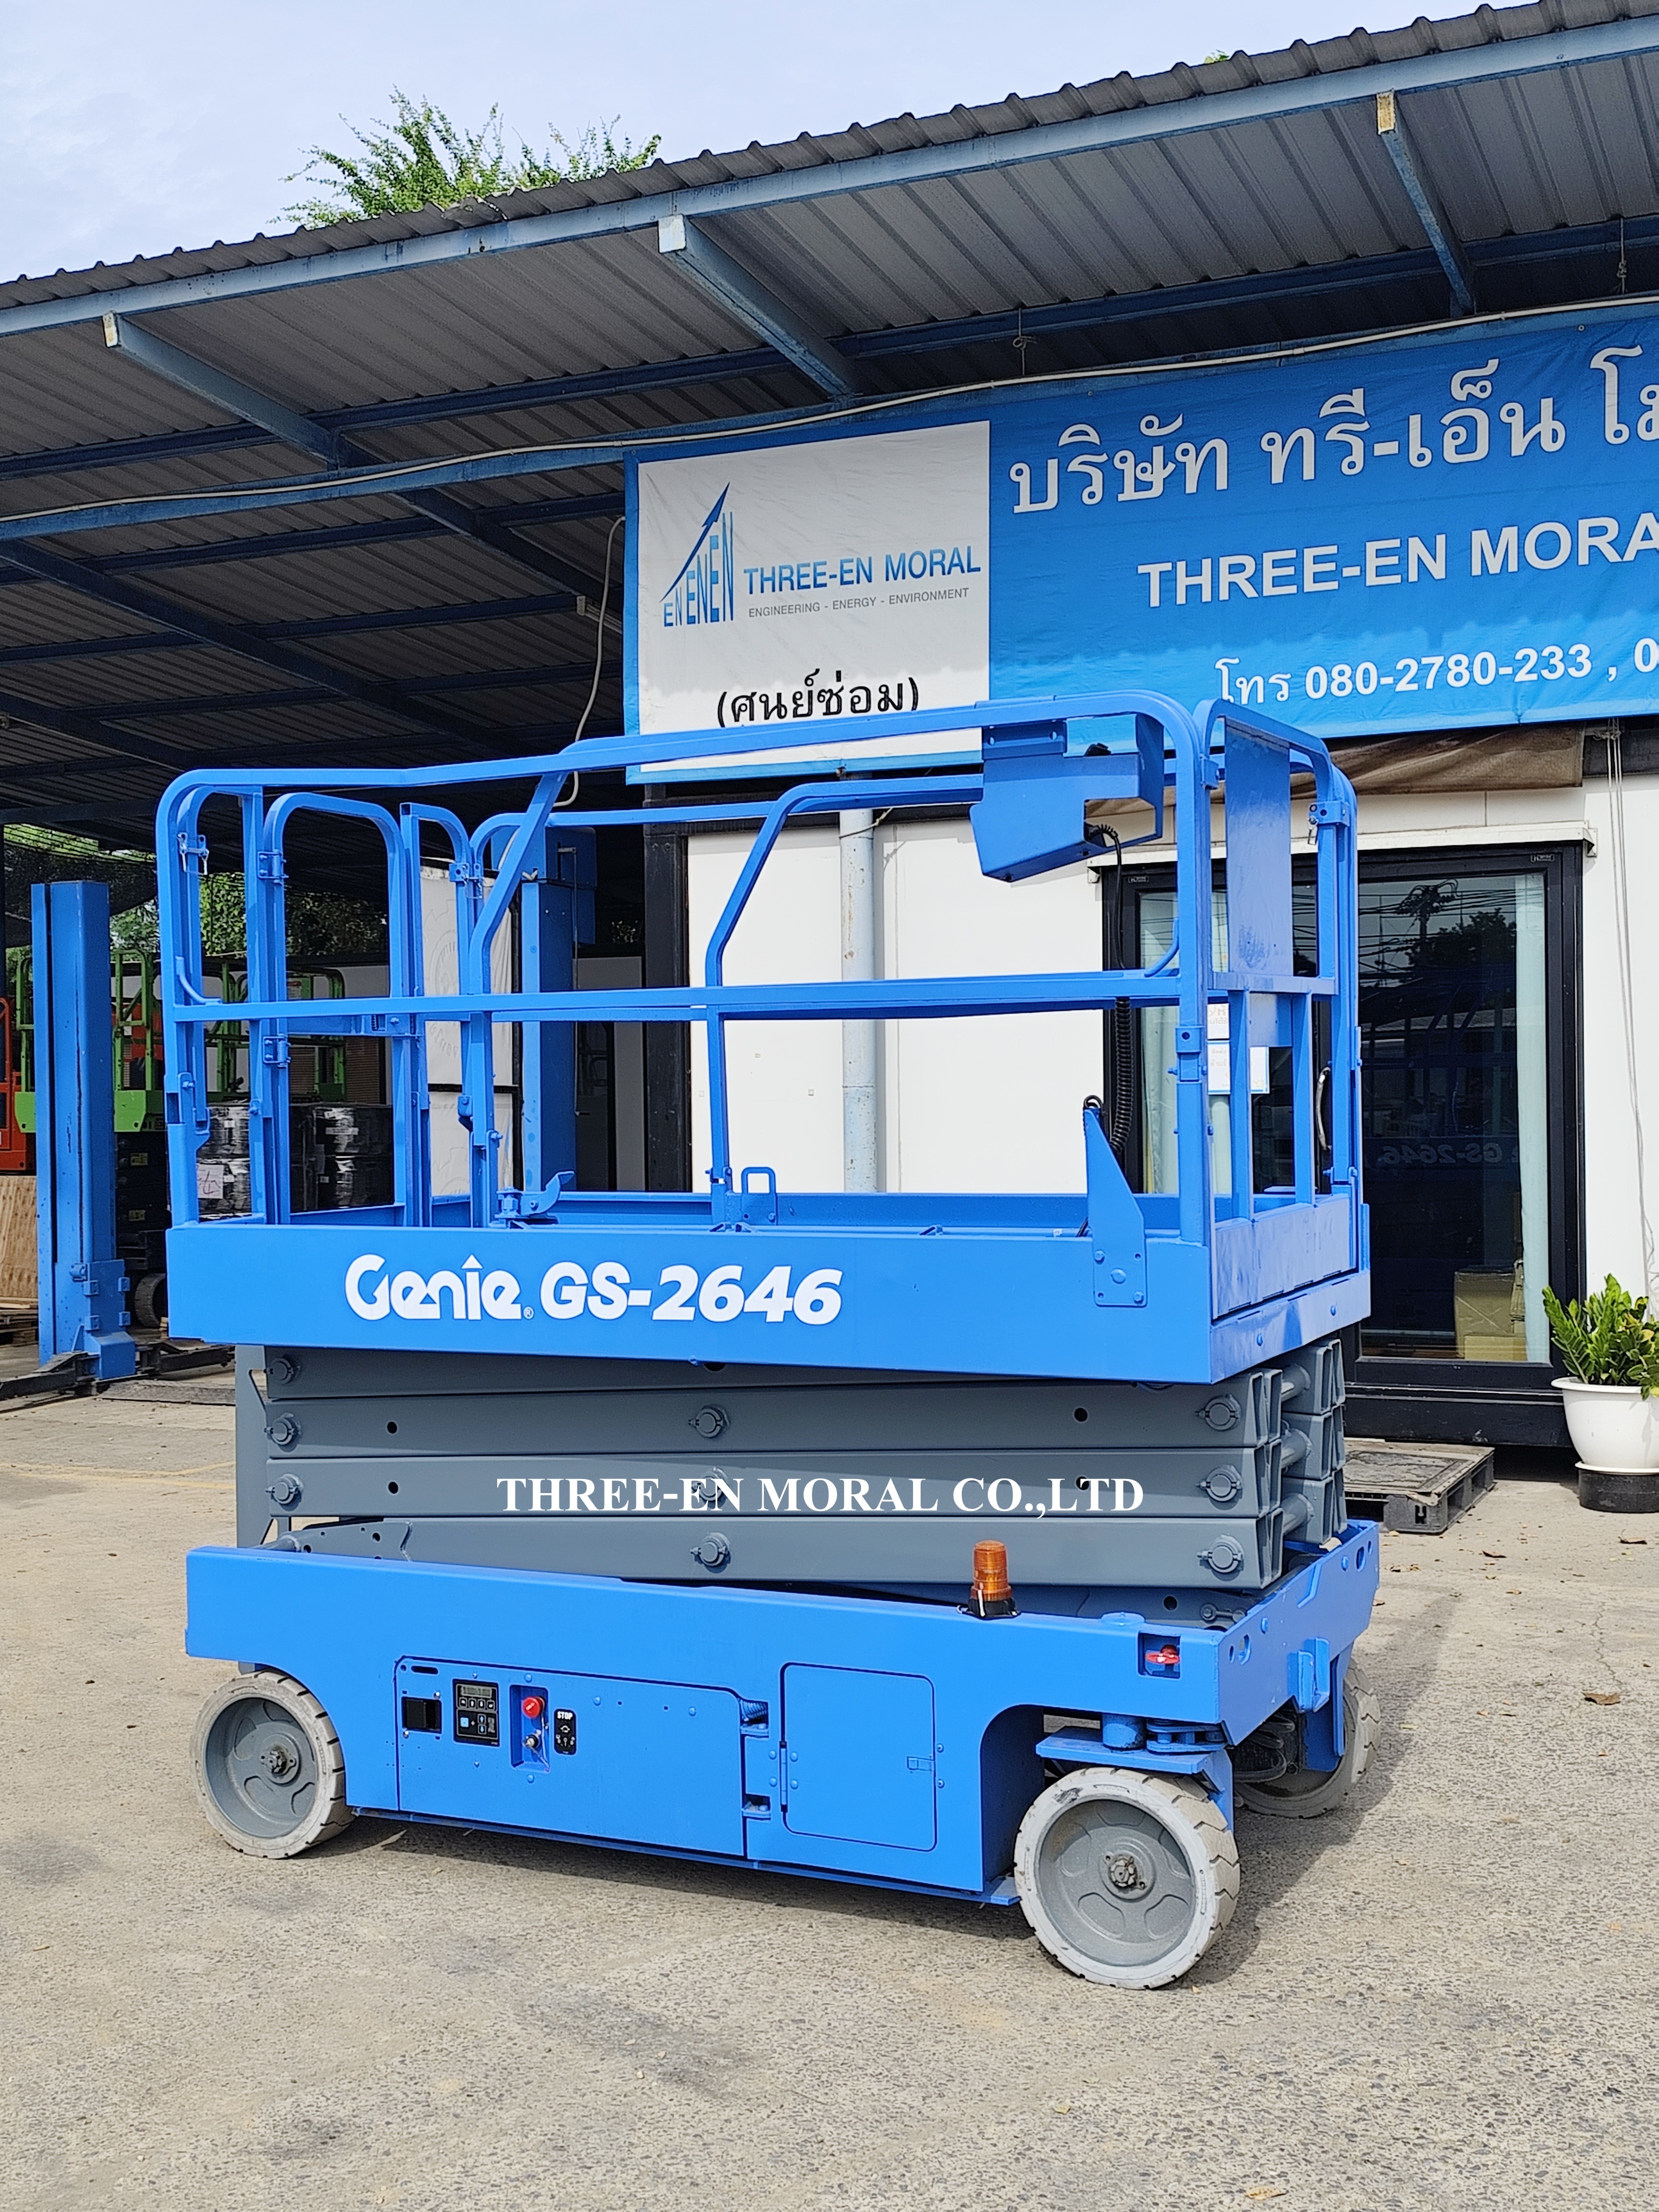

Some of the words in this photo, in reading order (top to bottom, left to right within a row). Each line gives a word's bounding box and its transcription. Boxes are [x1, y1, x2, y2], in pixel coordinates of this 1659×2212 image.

[1009, 413, 1229, 513] บริษัท
[1261, 358, 1566, 485] ทรี-เอ็น
[743, 556, 872, 595] THREE-EN
[885, 545, 981, 582] MORAL
[1137, 533, 1446, 608] THREE-EN
[1470, 511, 1659, 577] MORA
[749, 602, 820, 618] ENGINEERING
[832, 596, 877, 610] ENERGY
[889, 587, 970, 605] ENVIRONMENT
[1215, 657, 1292, 705] โทร
[1304, 643, 1592, 699] 080-2780-233
[541, 1261, 843, 1325] GS-2646
[557, 1711, 573, 1720] STOP
